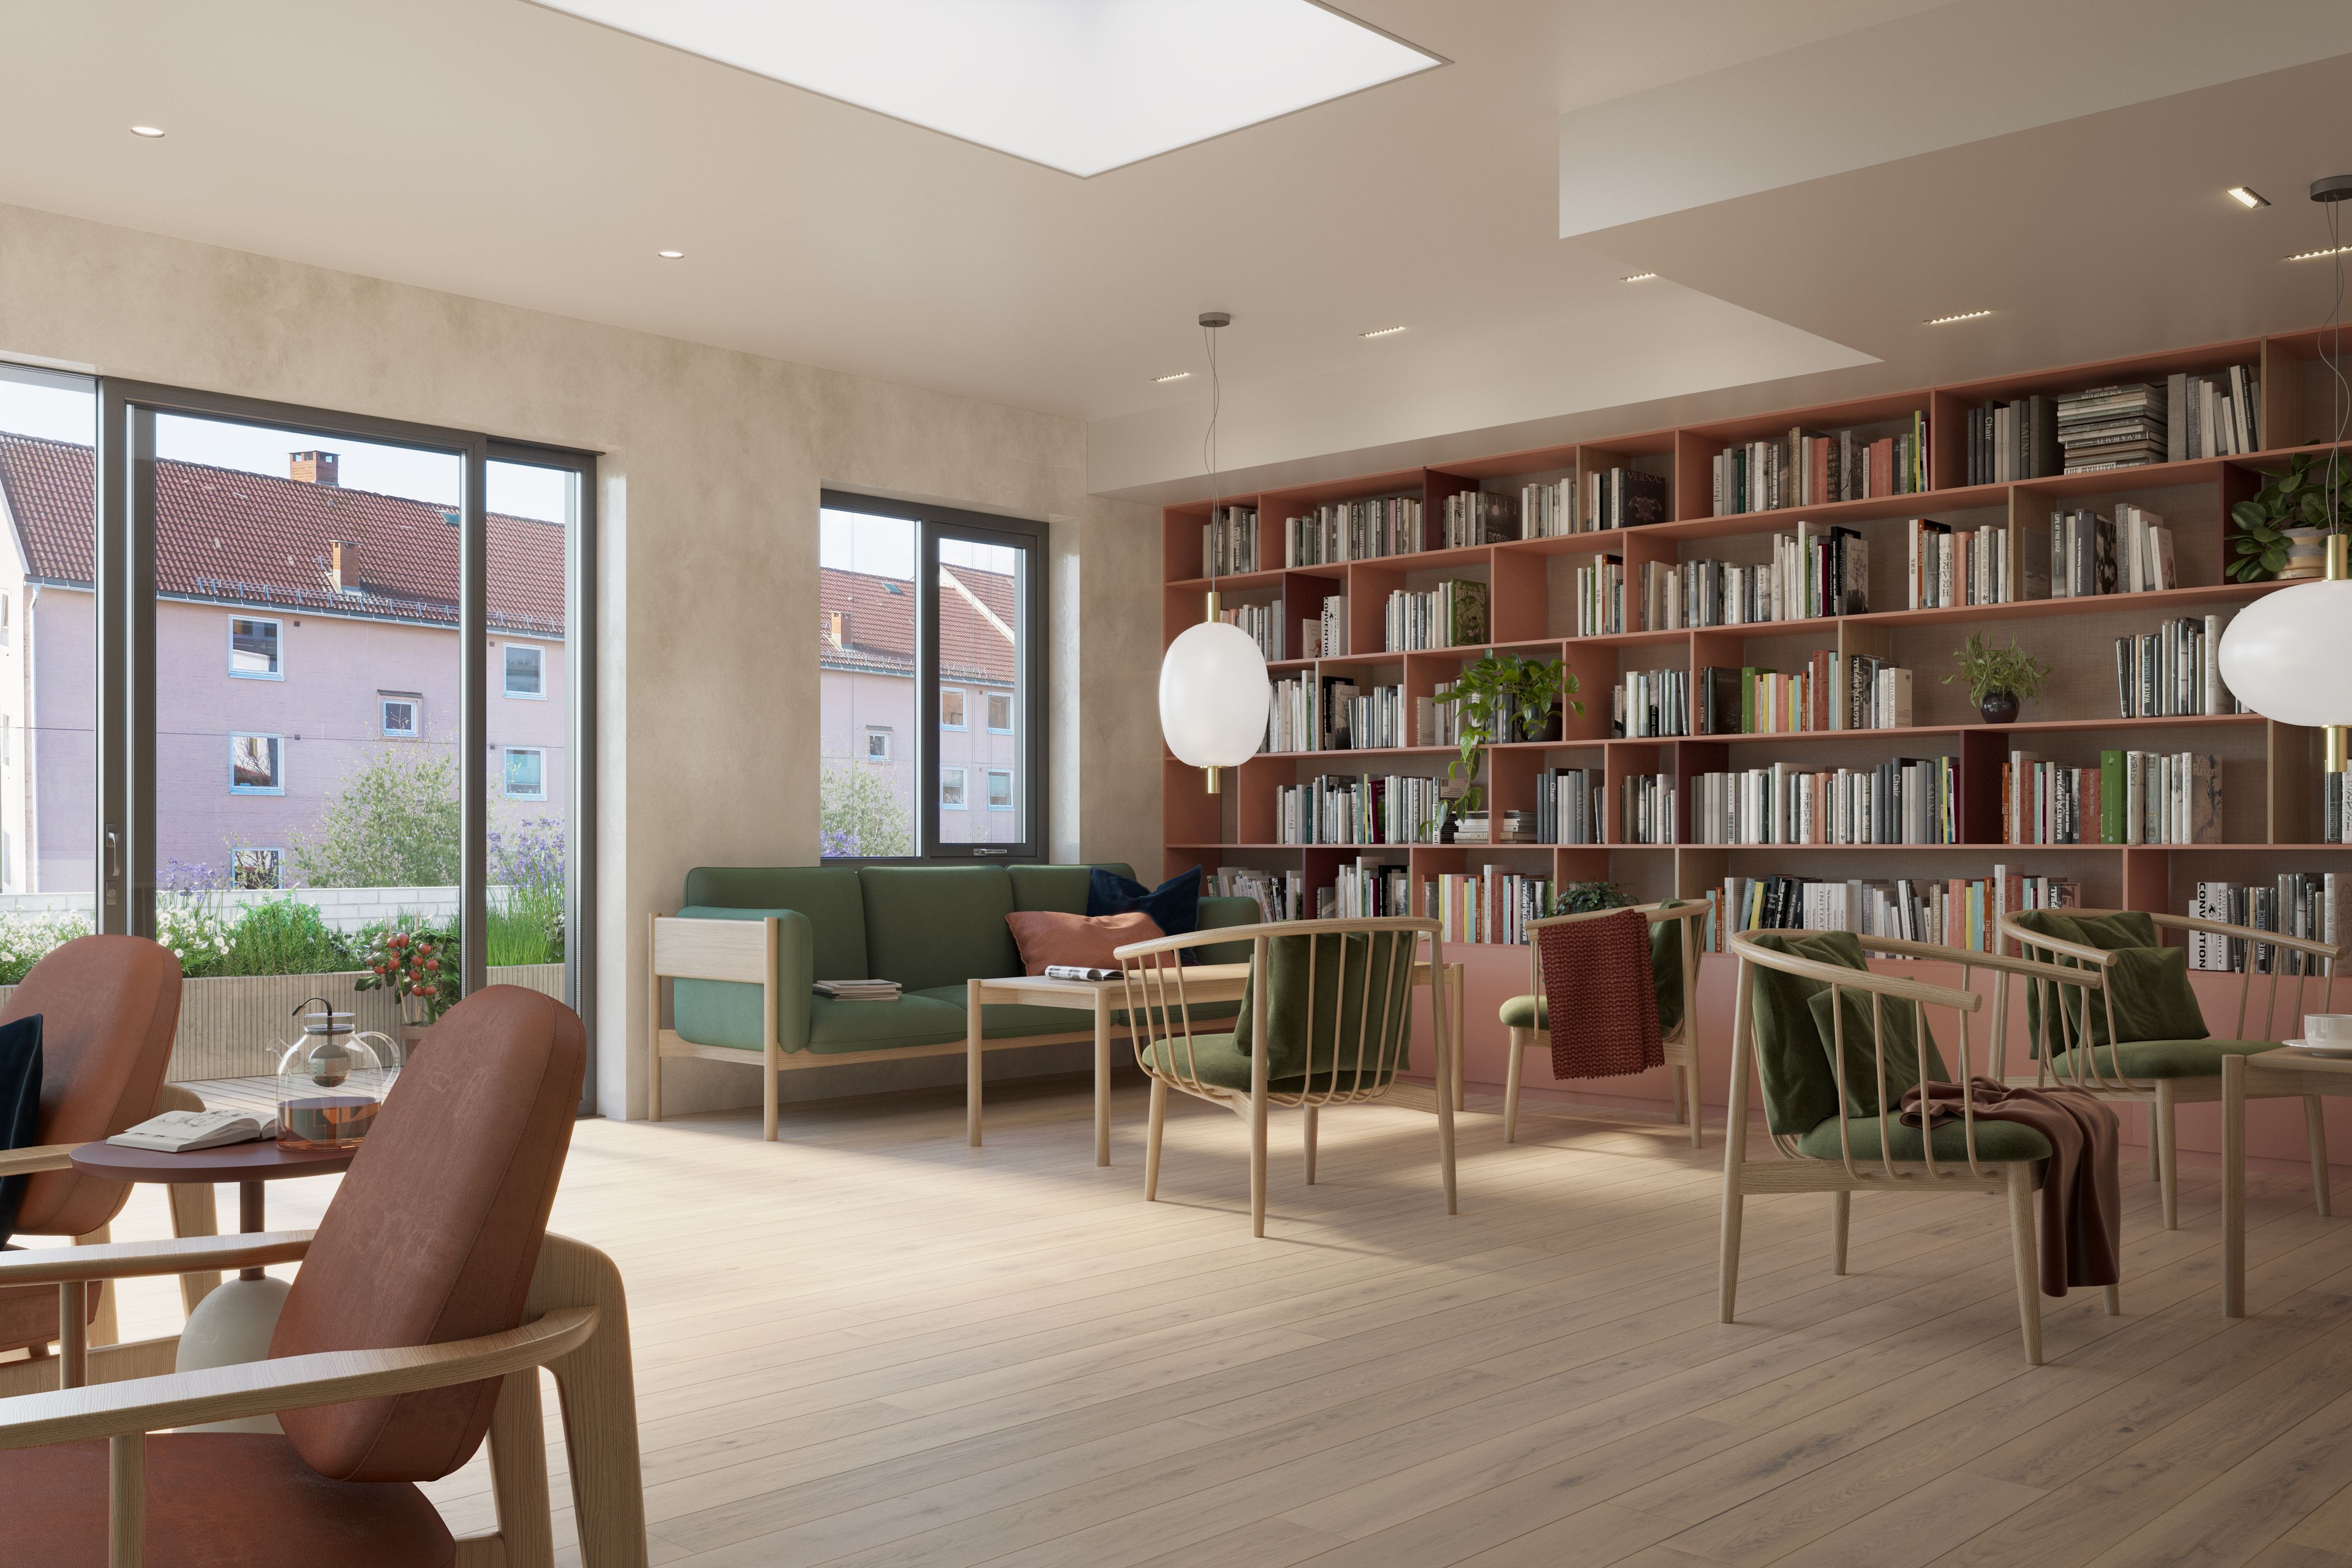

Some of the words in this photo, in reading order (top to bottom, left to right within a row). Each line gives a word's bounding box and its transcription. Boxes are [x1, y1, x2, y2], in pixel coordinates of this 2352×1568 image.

[1627, 471, 1662, 484] VERNAL
[2197, 755, 2210, 767] Kite
[2193, 763, 2215, 776] Runner
